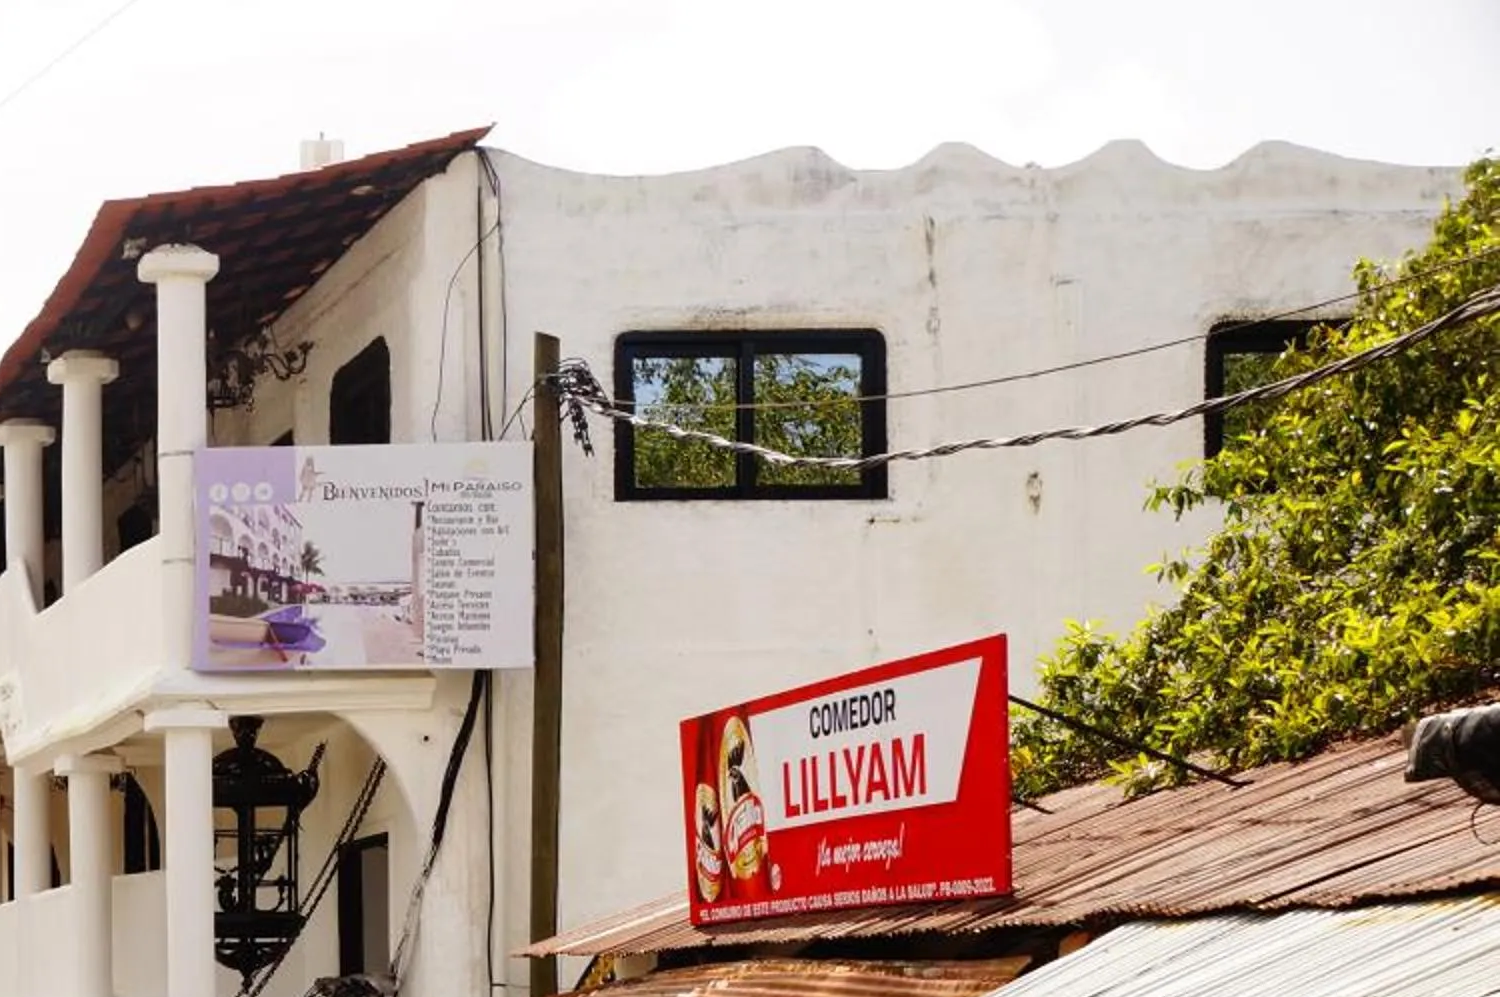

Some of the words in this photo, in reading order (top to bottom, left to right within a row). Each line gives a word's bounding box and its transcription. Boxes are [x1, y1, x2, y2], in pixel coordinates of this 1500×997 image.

[809, 688, 897, 739] COMEDOR
[783, 733, 927, 818] LILLYAM
[895, 884, 907, 900] LA
